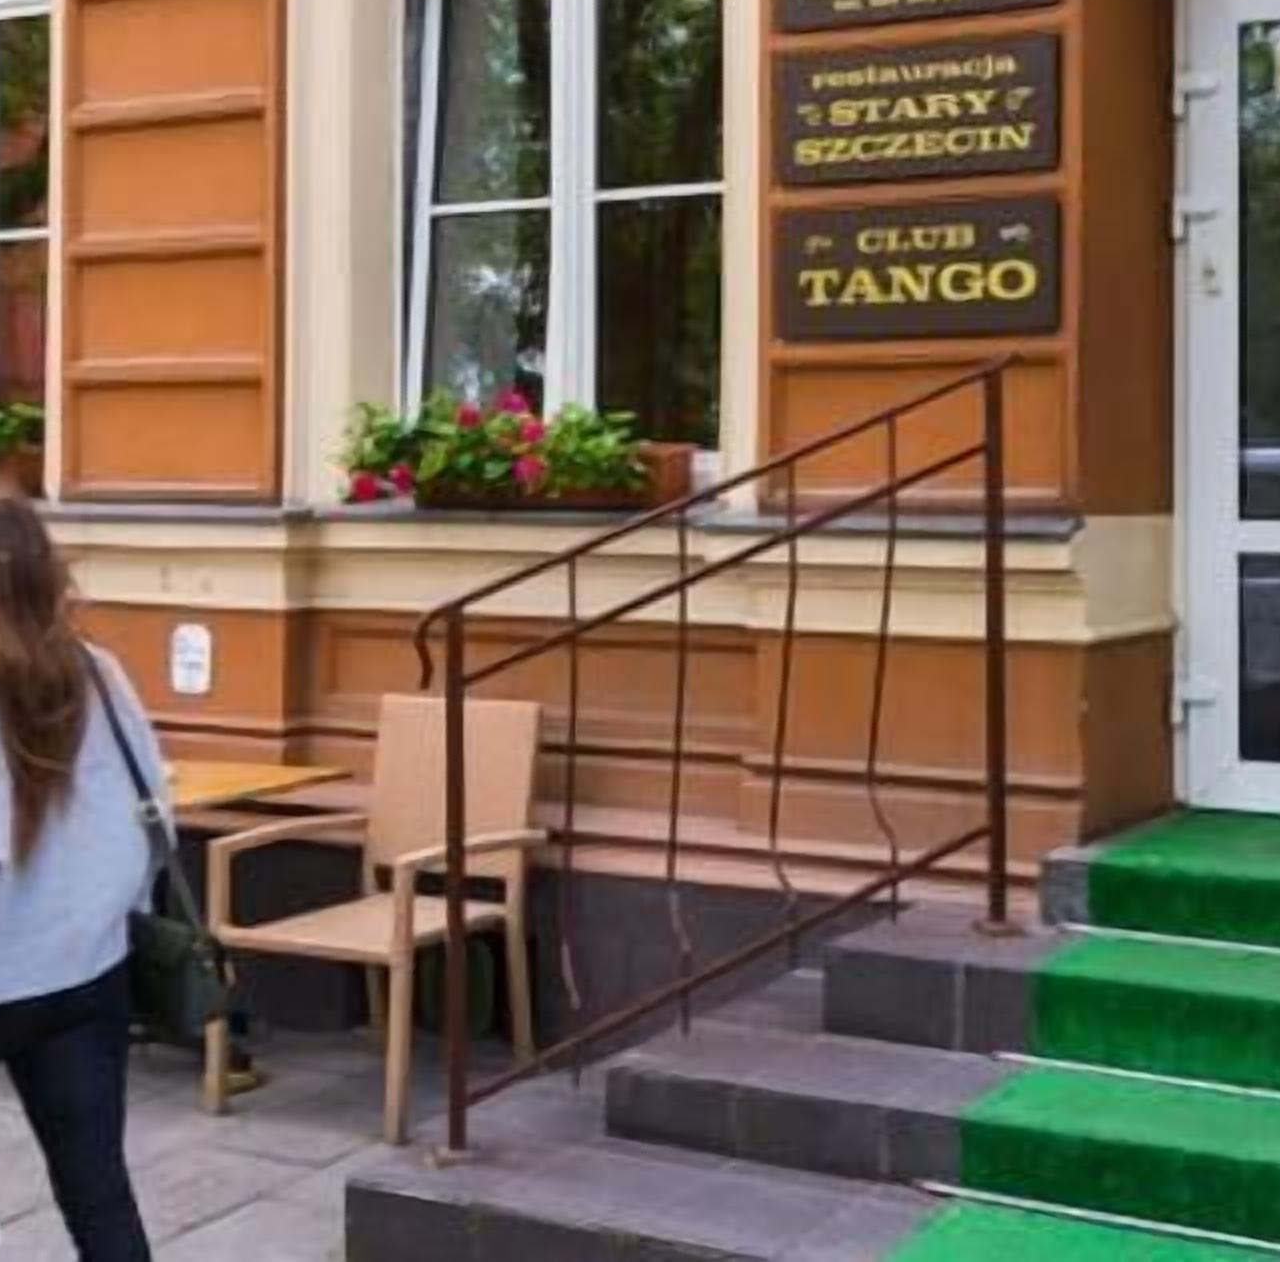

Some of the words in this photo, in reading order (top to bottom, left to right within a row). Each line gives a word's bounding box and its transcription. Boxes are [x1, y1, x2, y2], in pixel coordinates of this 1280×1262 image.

[812, 54, 1018, 90] restauracja
[828, 89, 996, 127] STARY
[794, 122, 1036, 167] SZCZECIN
[856, 223, 976, 254] CLUB
[798, 258, 1037, 307] TANGO
